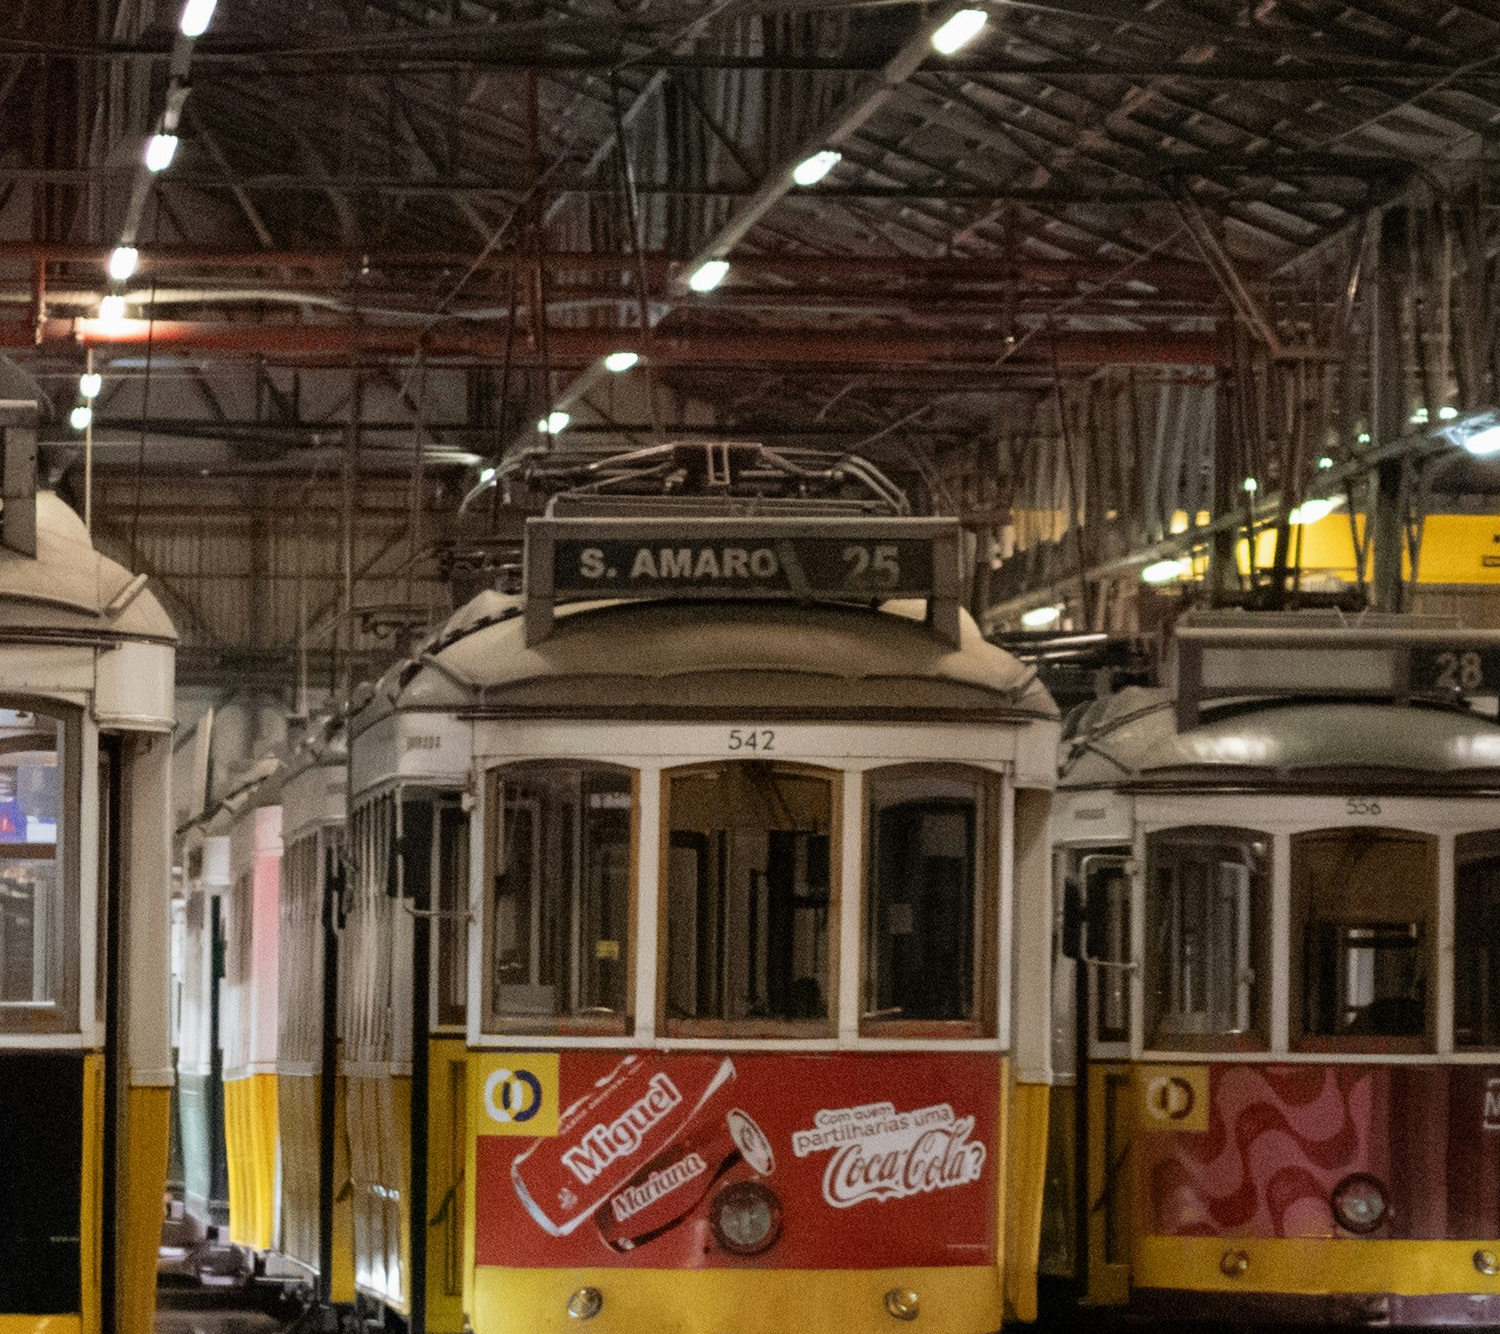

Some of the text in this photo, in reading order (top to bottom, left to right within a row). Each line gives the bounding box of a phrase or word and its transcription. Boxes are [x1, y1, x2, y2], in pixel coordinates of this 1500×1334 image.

[580, 547, 778, 579] S. AMARO
[843, 545, 900, 588] 25
[1434, 651, 1484, 689] 28
[728, 729, 776, 751] 542
[561, 1072, 683, 1185] Miguel
[797, 1107, 951, 1152] partilharias uma
[819, 1105, 893, 1126] Com quem
[612, 1153, 708, 1222] Mariana
